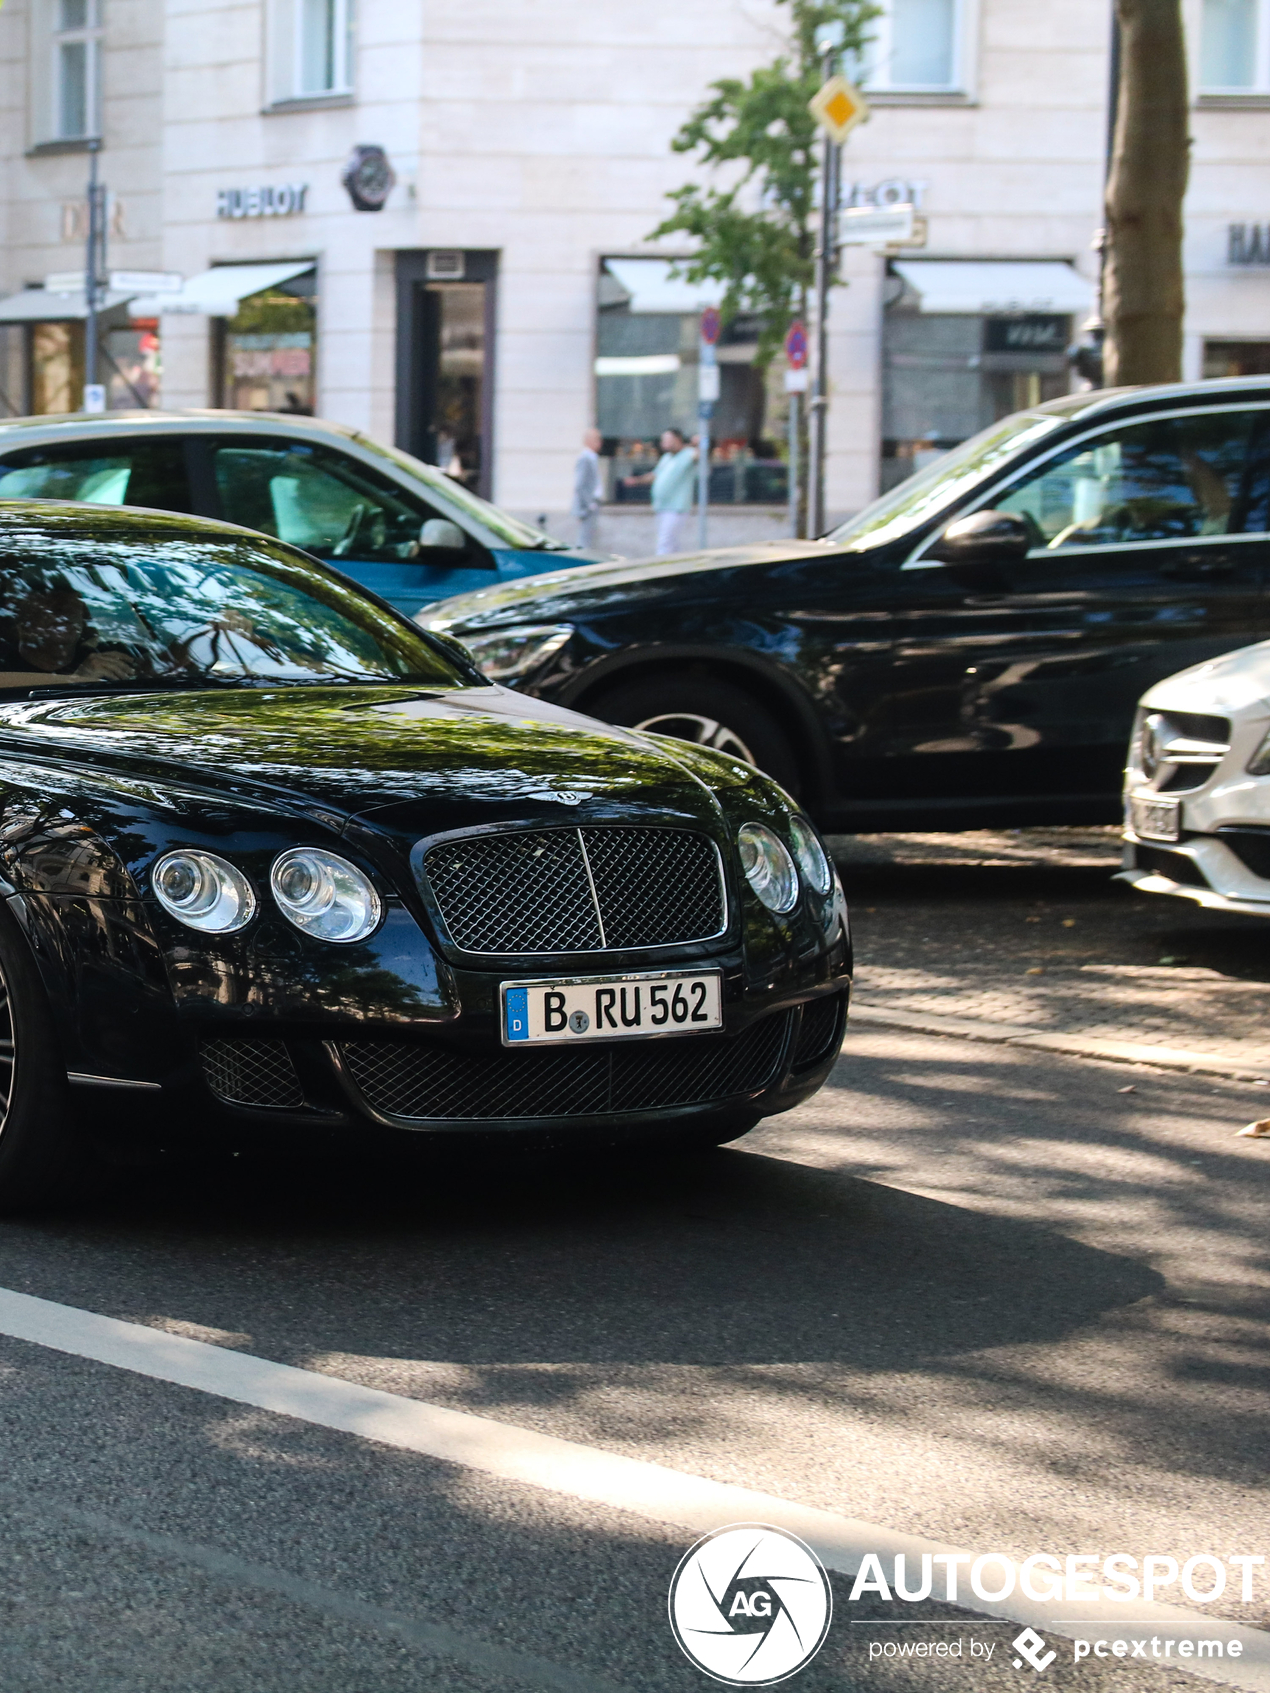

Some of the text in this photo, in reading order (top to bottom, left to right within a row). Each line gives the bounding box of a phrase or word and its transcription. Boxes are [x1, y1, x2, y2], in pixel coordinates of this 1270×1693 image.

[217, 183, 308, 219] HUBLOT
[544, 981, 708, 1032] B RU 562
[513, 1019, 522, 1031] D
